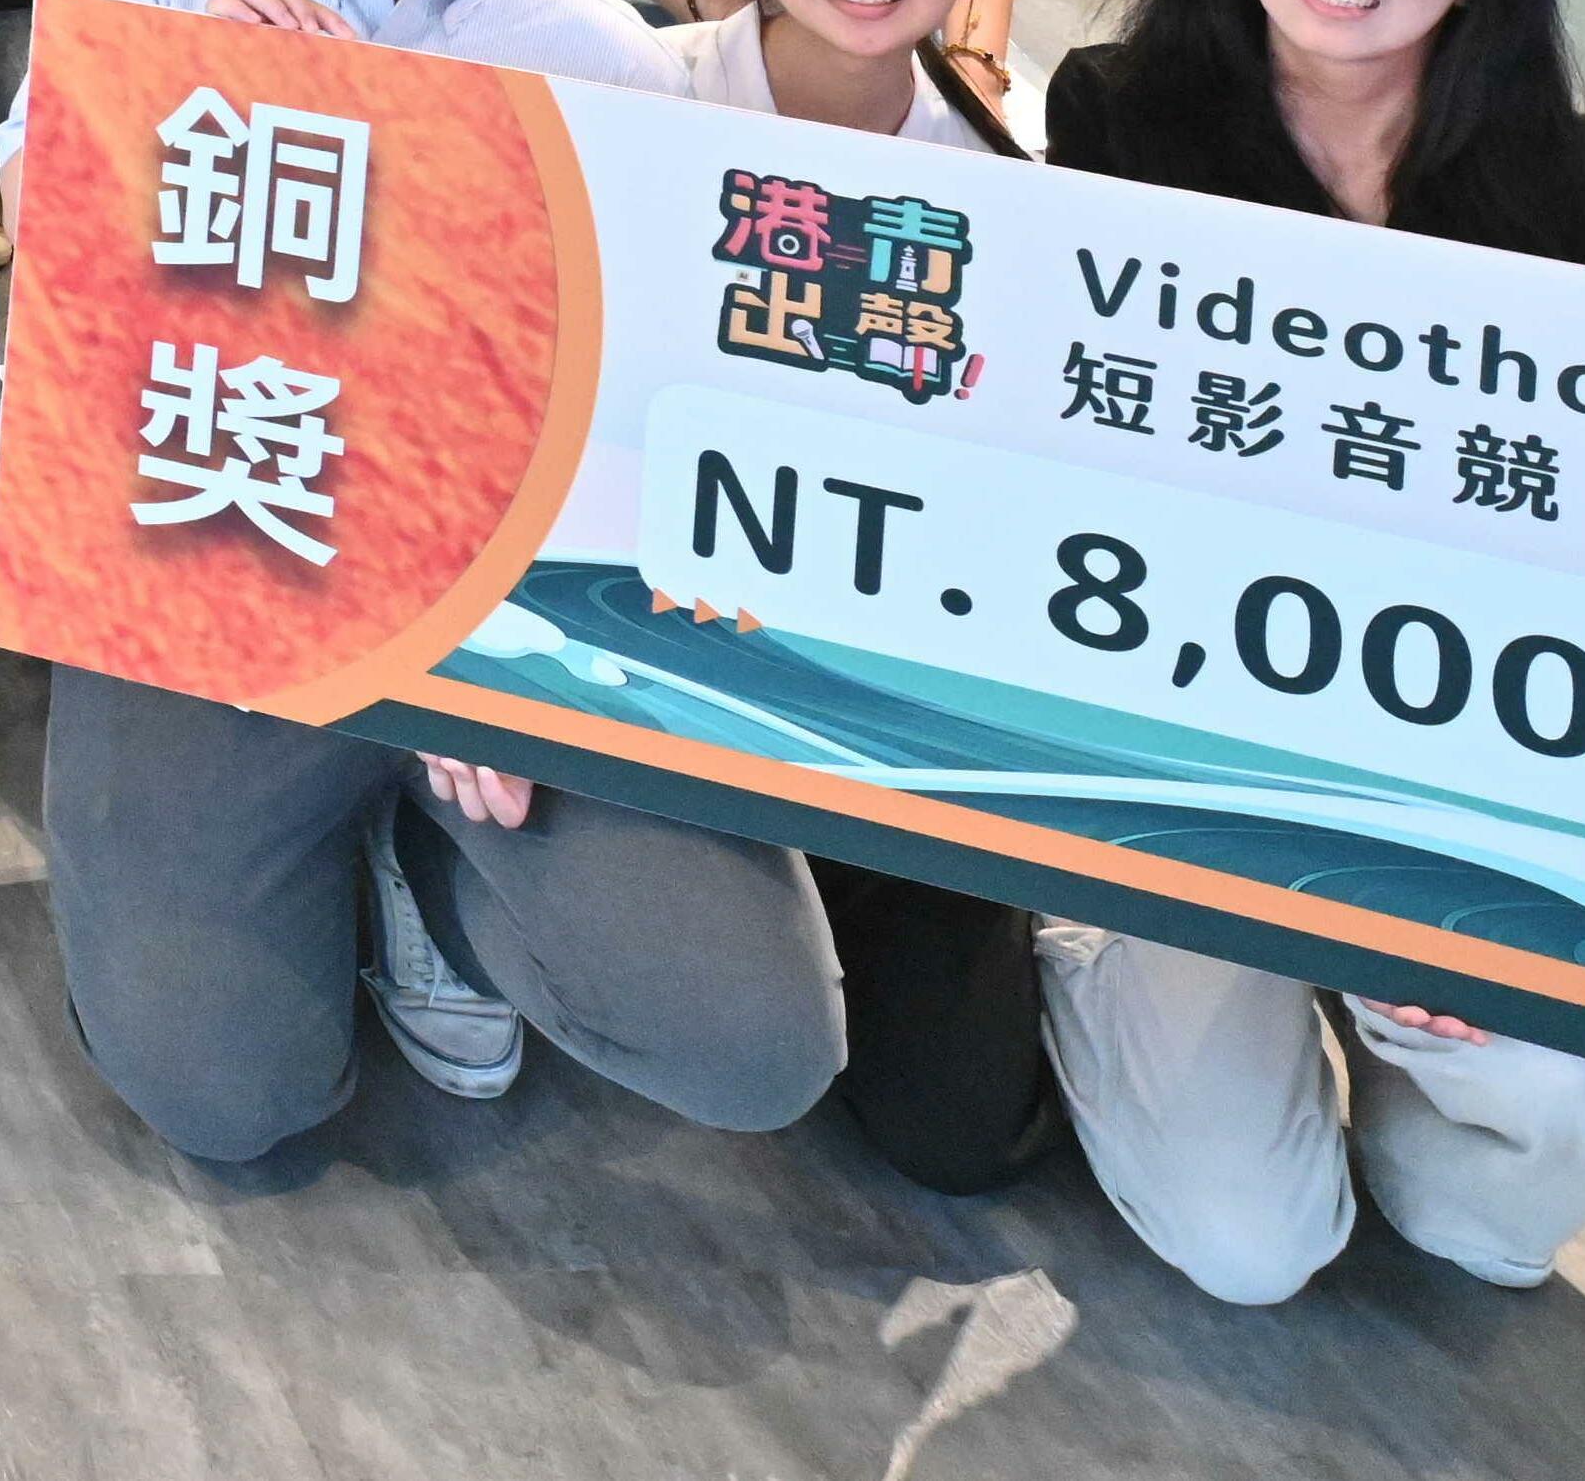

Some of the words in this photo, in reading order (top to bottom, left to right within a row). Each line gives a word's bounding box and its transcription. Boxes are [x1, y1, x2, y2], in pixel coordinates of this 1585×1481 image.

[129, 86, 371, 568] 銅獎
[1061, 341, 1560, 522] 短影音競
[693, 450, 972, 616] NT.
[1048, 533, 1585, 758] 8,000
